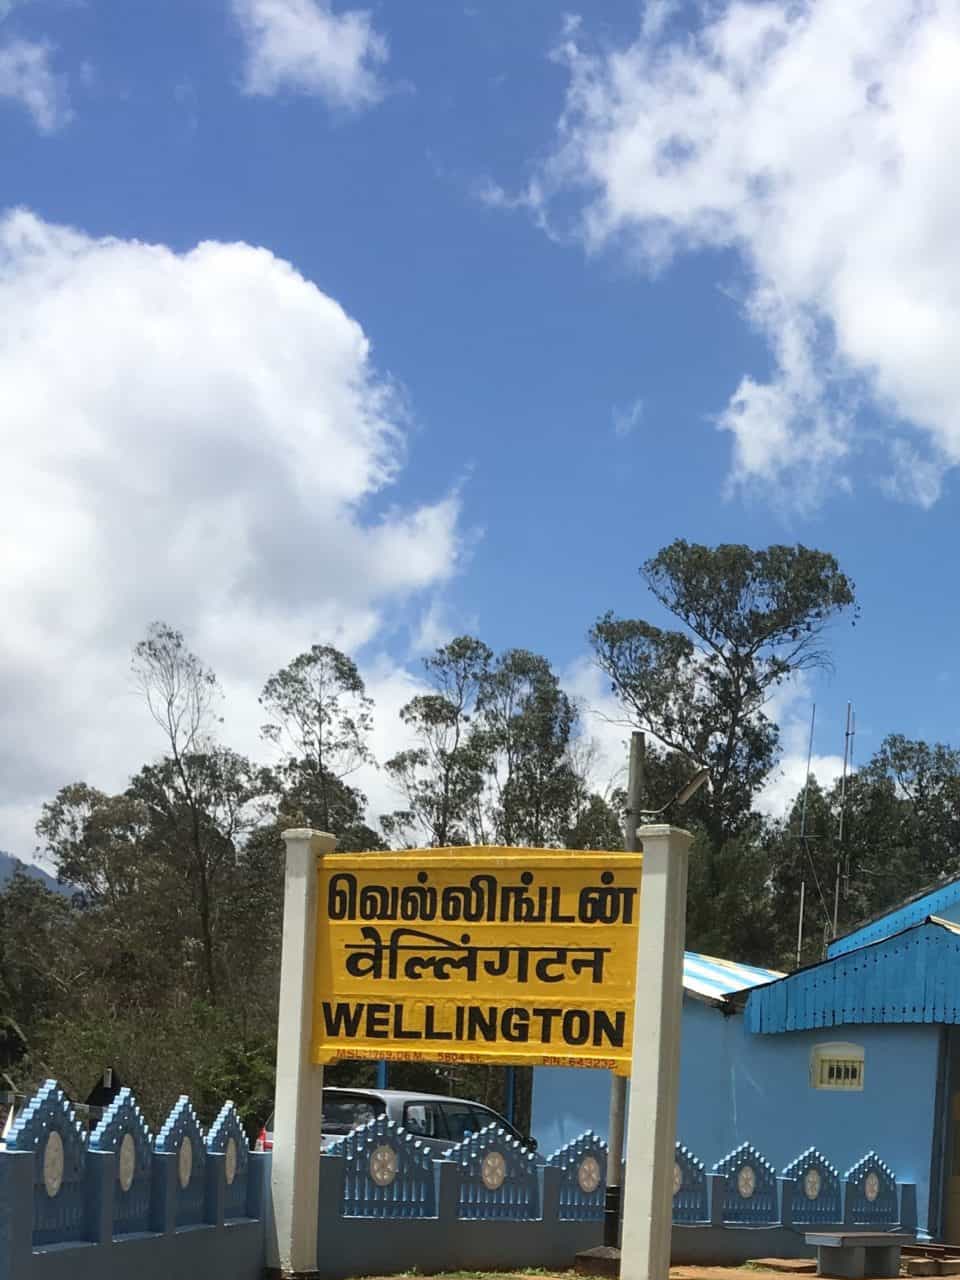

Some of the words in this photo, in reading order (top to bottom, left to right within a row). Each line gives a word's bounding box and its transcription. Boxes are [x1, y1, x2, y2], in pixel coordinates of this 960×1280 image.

[328, 871, 637, 924] வெல்லிங்டன்
[344, 927, 612, 983] वेल्लिंगटन
[322, 1001, 626, 1047] WELLINGTON
